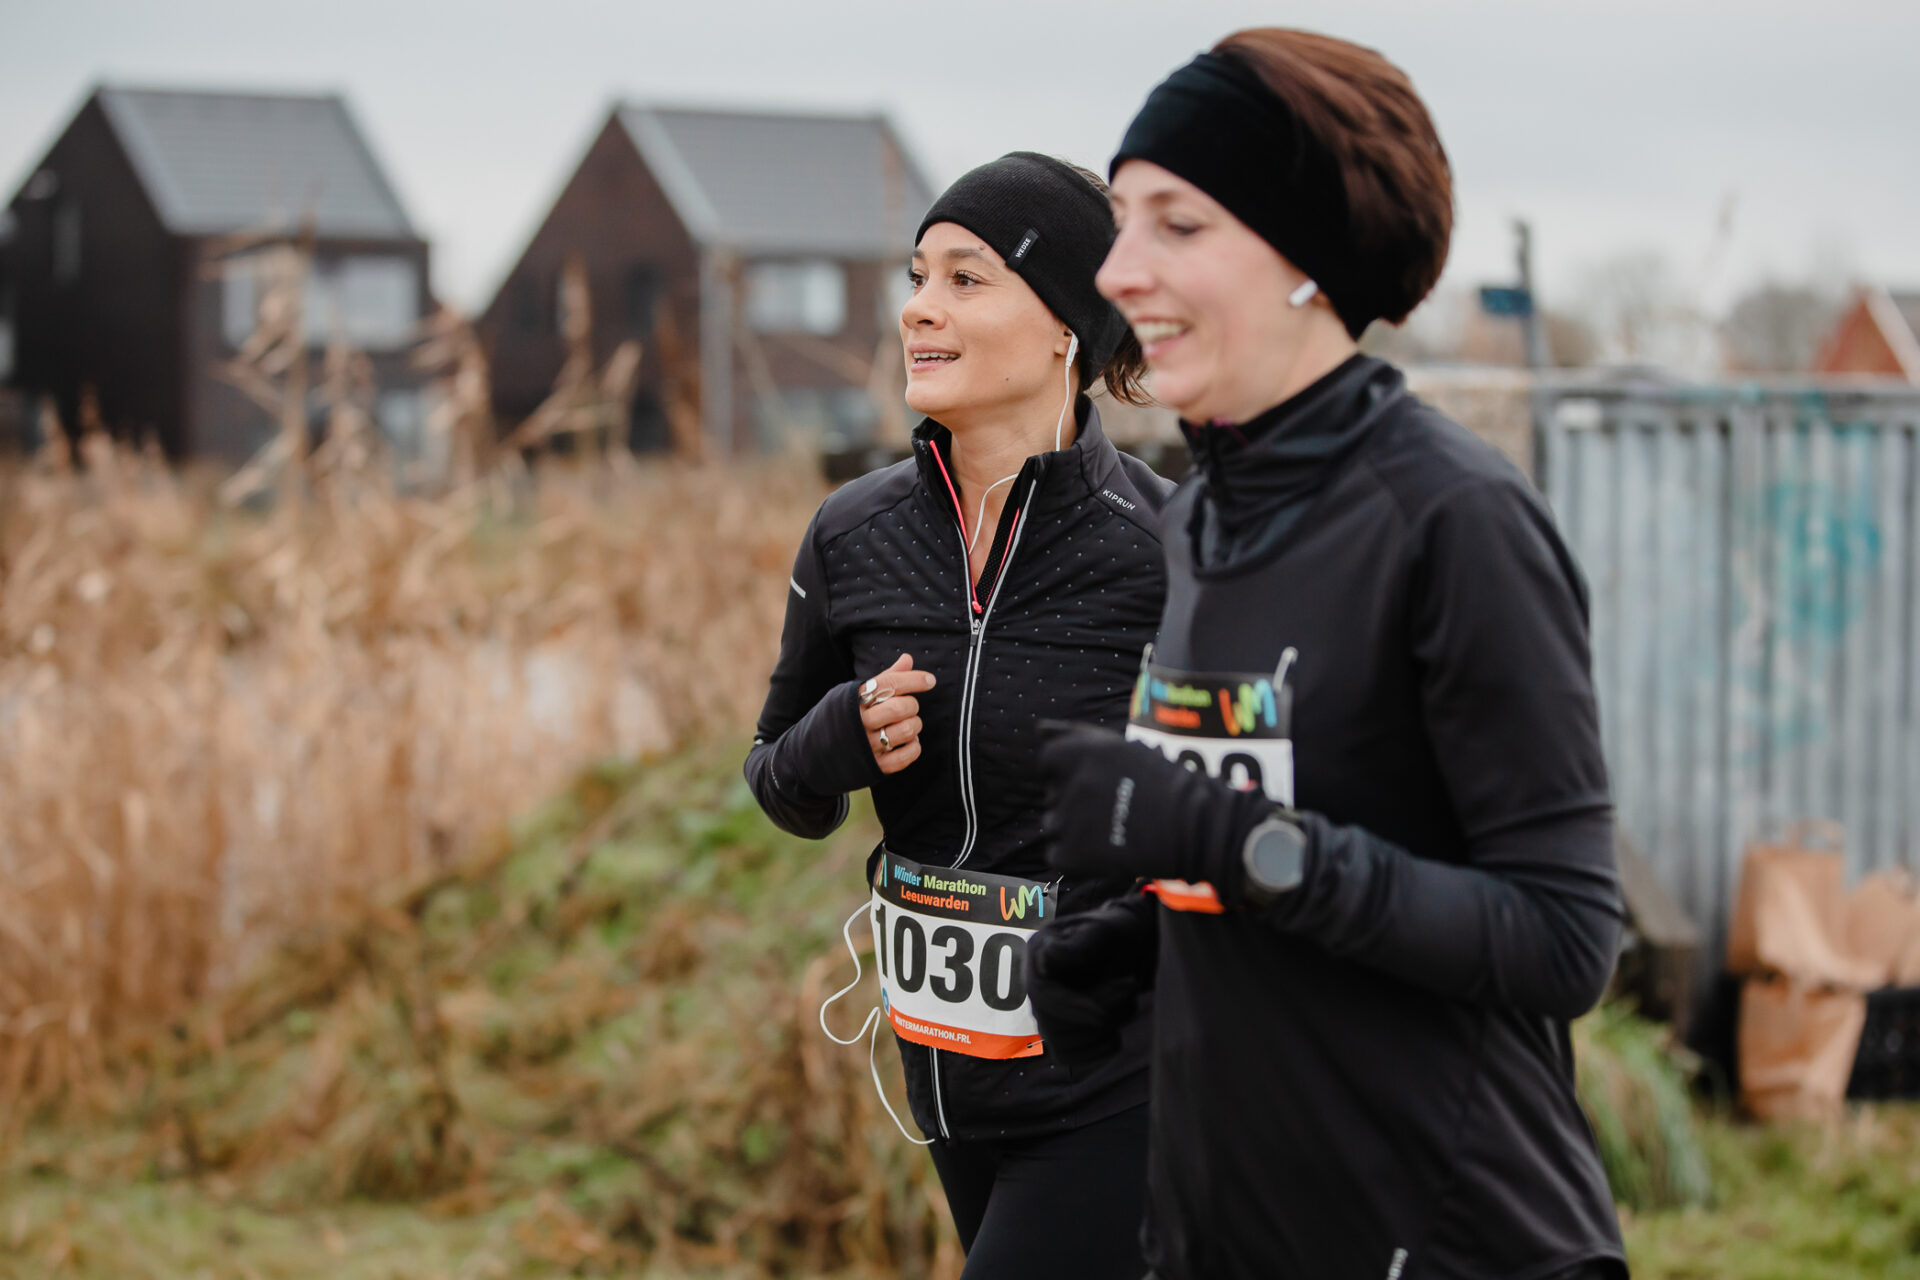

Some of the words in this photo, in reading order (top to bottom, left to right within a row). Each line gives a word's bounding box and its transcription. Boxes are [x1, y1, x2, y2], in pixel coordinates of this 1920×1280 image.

[1015, 237, 1031, 258] WEDZE
[1102, 489, 1136, 510] KIPRUN
[894, 864, 922, 886] Winter
[923, 875, 987, 896] Marathon
[901, 886, 969, 911] Leeuwarden
[875, 903, 1028, 1011] 1030
[895, 1015, 971, 1044] WINTERMARATHON.FRL
